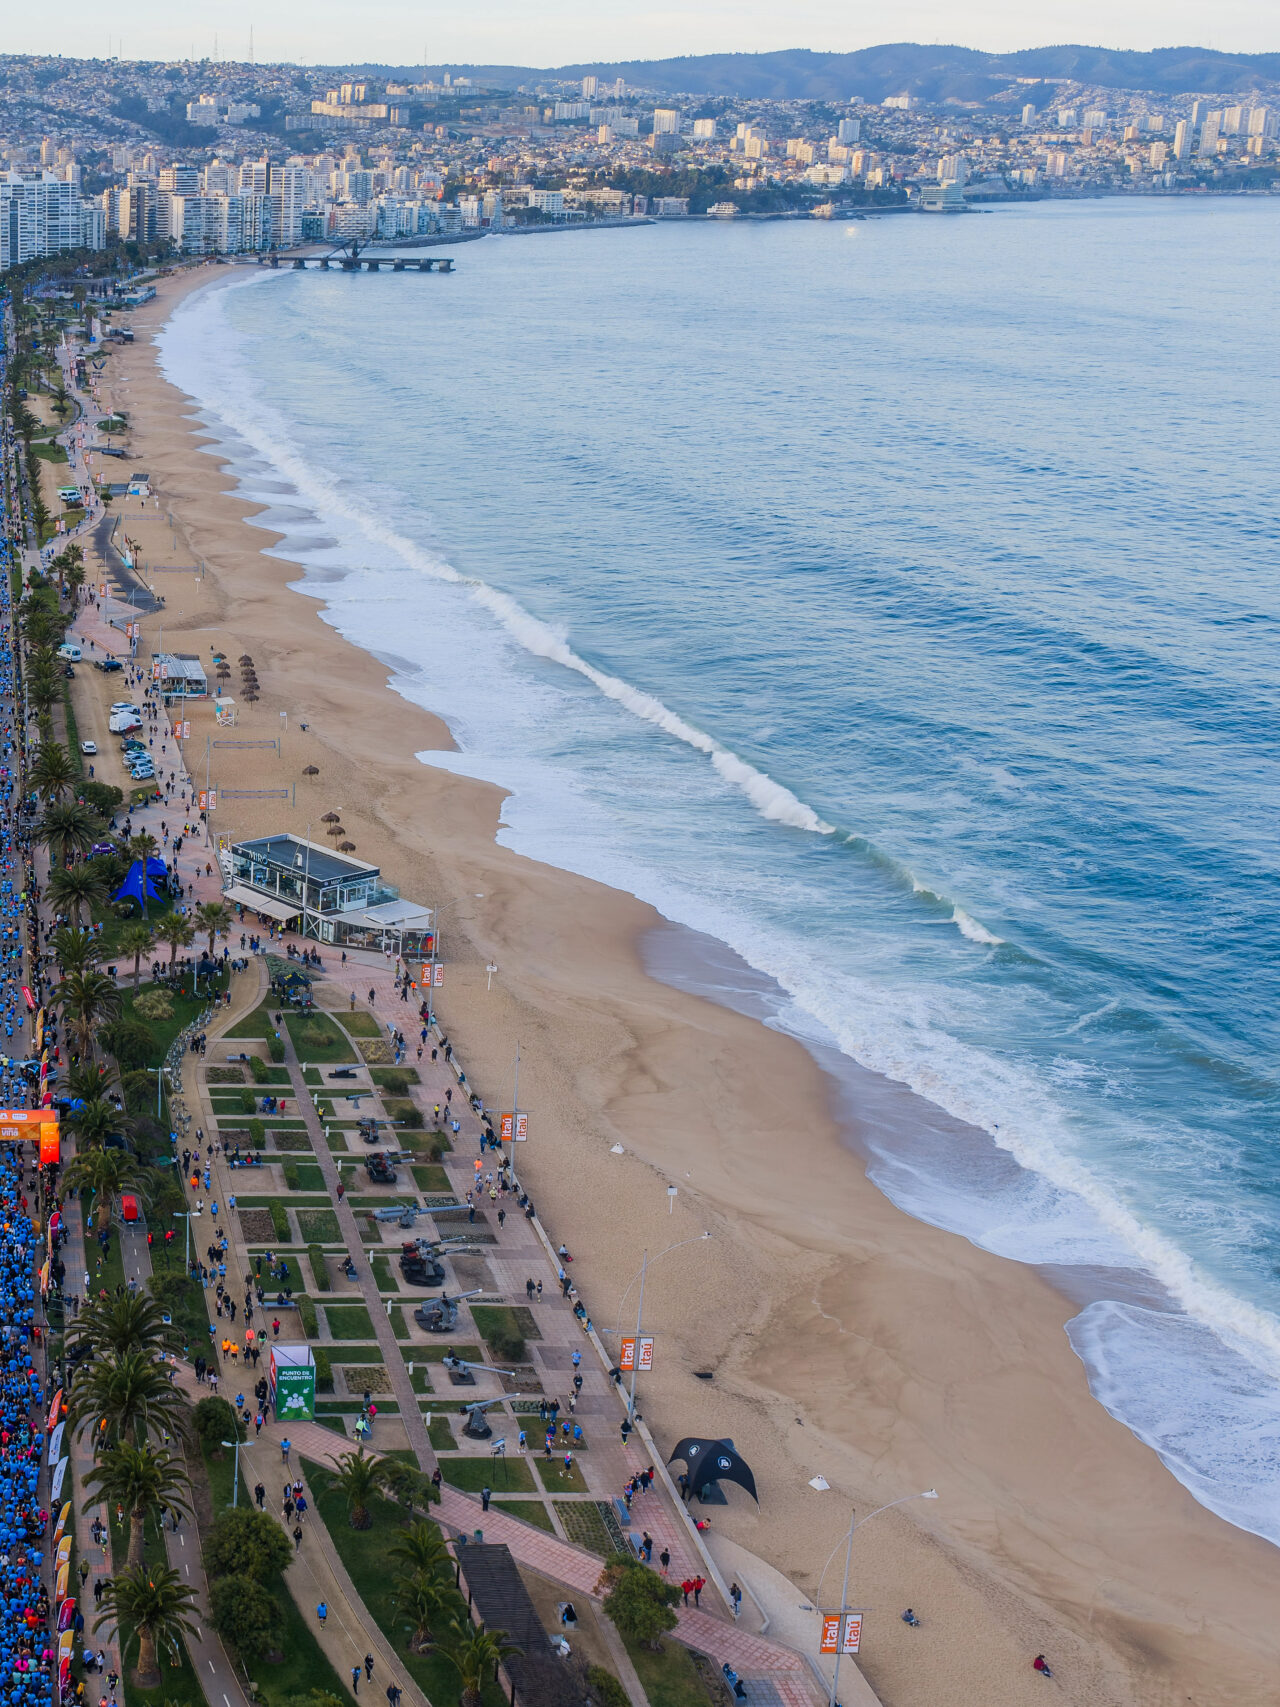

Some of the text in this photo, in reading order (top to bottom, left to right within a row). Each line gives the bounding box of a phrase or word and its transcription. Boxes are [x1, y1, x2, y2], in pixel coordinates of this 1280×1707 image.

[422, 967, 431, 984] itaú
[434, 967, 443, 984] itaú
[502, 1118, 512, 1136] itaú
[517, 1118, 527, 1137] itaú
[621, 1343, 634, 1365] itaú
[640, 1343, 652, 1365] itaú
[822, 1621, 839, 1648] itaú
[844, 1621, 861, 1647] itaú
